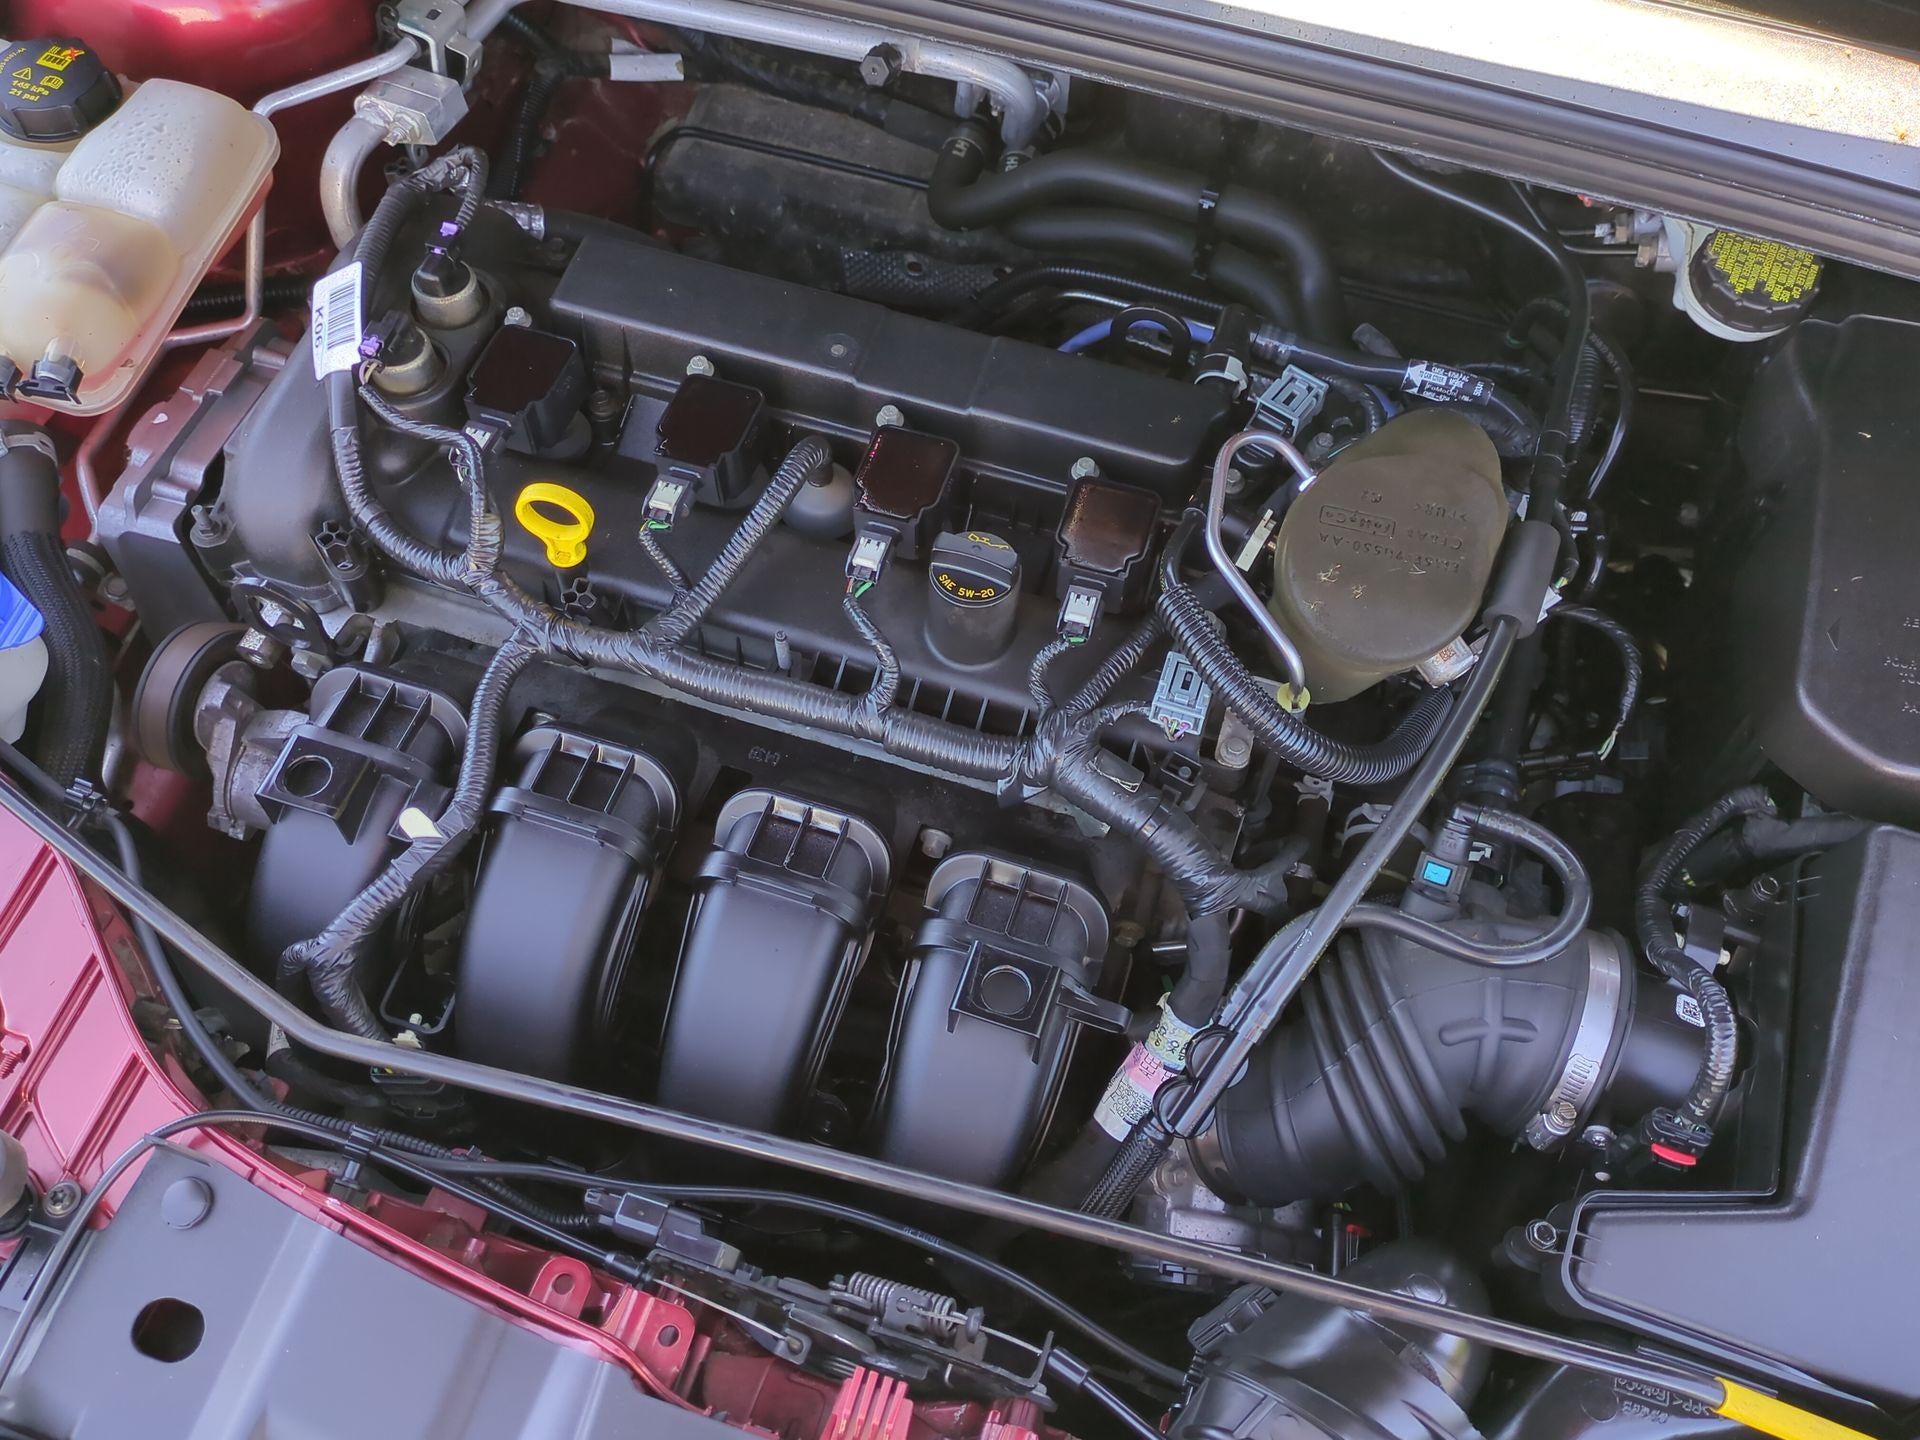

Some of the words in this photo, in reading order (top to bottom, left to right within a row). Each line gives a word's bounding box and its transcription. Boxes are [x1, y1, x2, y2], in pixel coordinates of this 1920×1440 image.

[8, 88, 22, 97] 21
[22, 92, 40, 102] psi
[30, 85, 50, 96] kPa
[952, 140, 970, 158] LH
[1791, 286, 1801, 299] CAP
[939, 574, 957, 590] SAE
[958, 587, 995, 598] 5W-20
[1166, 1040, 1180, 1055] OK
[1619, 1378, 1667, 1401] FoMoCo
